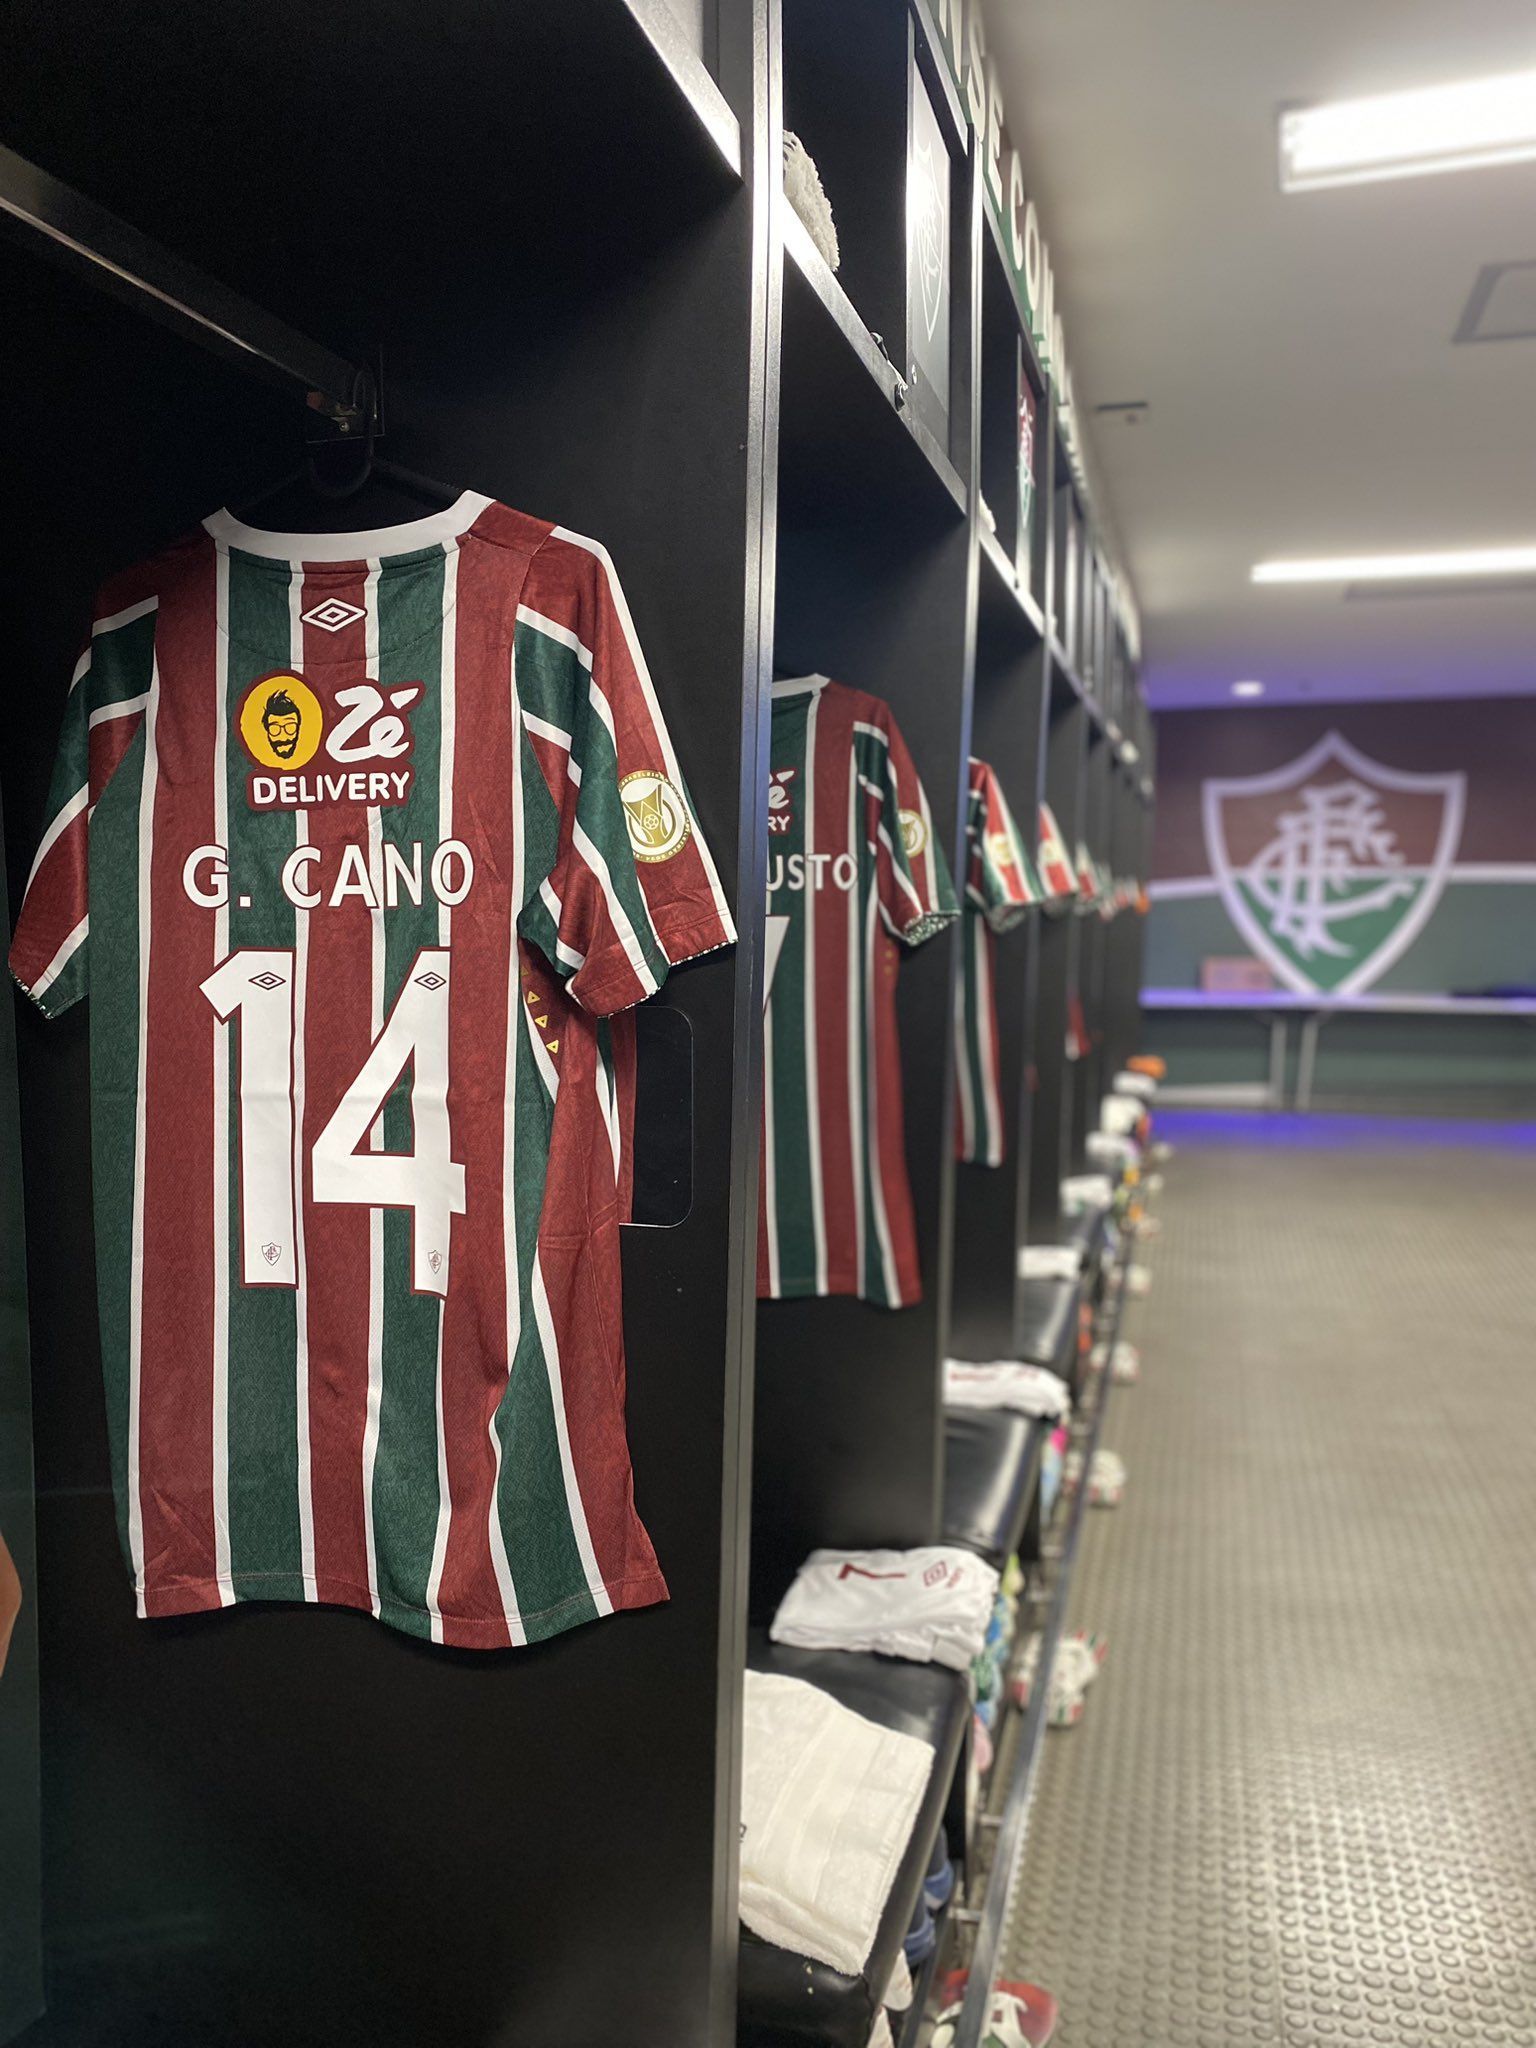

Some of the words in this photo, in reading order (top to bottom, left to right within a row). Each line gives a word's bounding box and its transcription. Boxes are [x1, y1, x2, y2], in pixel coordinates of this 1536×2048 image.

[325, 685, 419, 763] Zé
[252, 771, 410, 804] DELIVERY
[182, 844, 251, 909] G.
[281, 839, 474, 909] CANO
[198, 949, 467, 1297] 14
